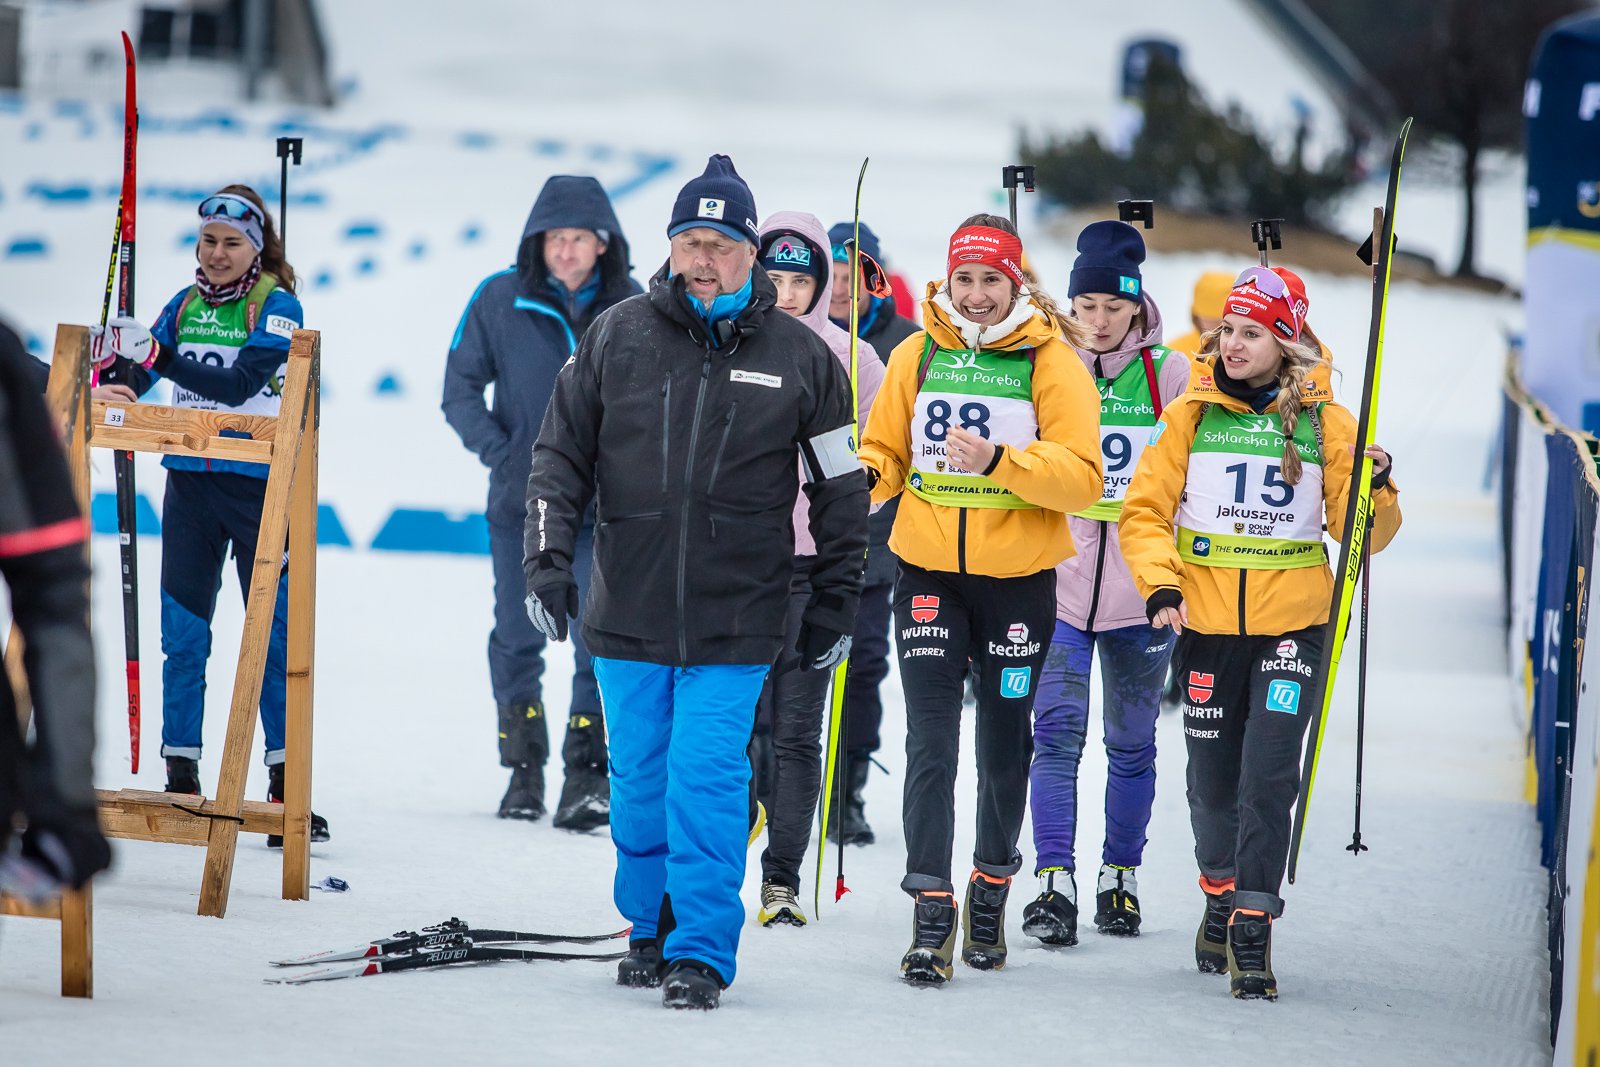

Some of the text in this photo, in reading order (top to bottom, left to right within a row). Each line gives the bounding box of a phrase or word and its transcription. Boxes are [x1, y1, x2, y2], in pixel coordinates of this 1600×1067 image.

[777, 247, 809, 262] KAZ
[106, 252, 118, 293] LEKI
[924, 369, 1022, 388] klarska Poręba
[110, 413, 122, 423] 33
[1203, 431, 1269, 448] Szklarska
[923, 483, 937, 493] THE
[937, 485, 981, 495] OFFICIAL
[982, 487, 1000, 495] IBU
[1225, 462, 1295, 508] 15
[1216, 505, 1295, 524] Jakuszyce
[1248, 524, 1275, 532] DOLNY
[538, 530, 546, 551] PRO
[1346, 494, 1367, 582] FISCHER
[1215, 545, 1232, 554] THE
[1233, 546, 1279, 556] OFFICIAL
[1296, 545, 1313, 555] APP
[911, 647, 945, 657] TERREX
[988, 641, 1040, 657] tectake
[1261, 658, 1312, 677] tectake
[1007, 672, 1026, 694] TQ
[1273, 684, 1296, 710] TQ
[1188, 728, 1219, 739] TERREX
[426, 949, 468, 962] PELTONEN
